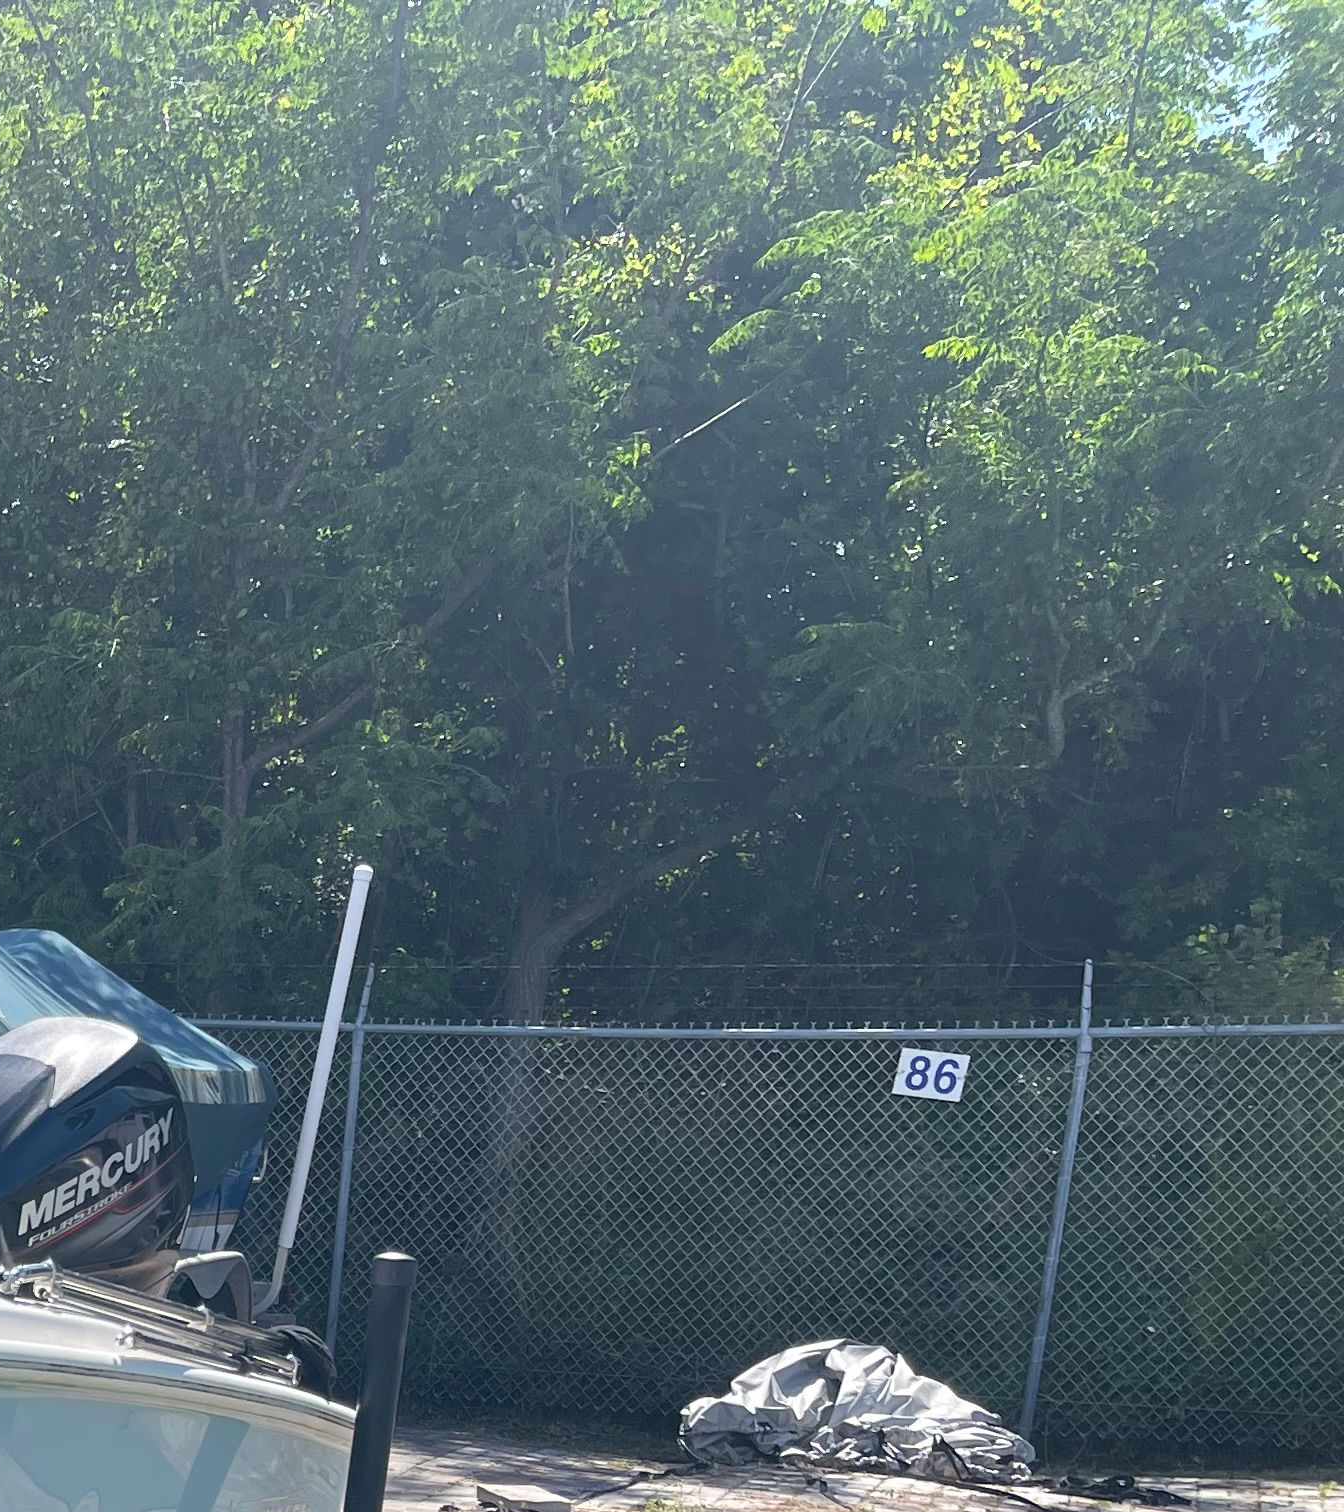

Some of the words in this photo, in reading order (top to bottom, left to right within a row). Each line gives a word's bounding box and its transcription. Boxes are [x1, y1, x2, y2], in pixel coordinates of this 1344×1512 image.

[905, 1056, 960, 1095] 86
[18, 1107, 174, 1236] MERCURY
[28, 1182, 133, 1247] FOURSTROKE
